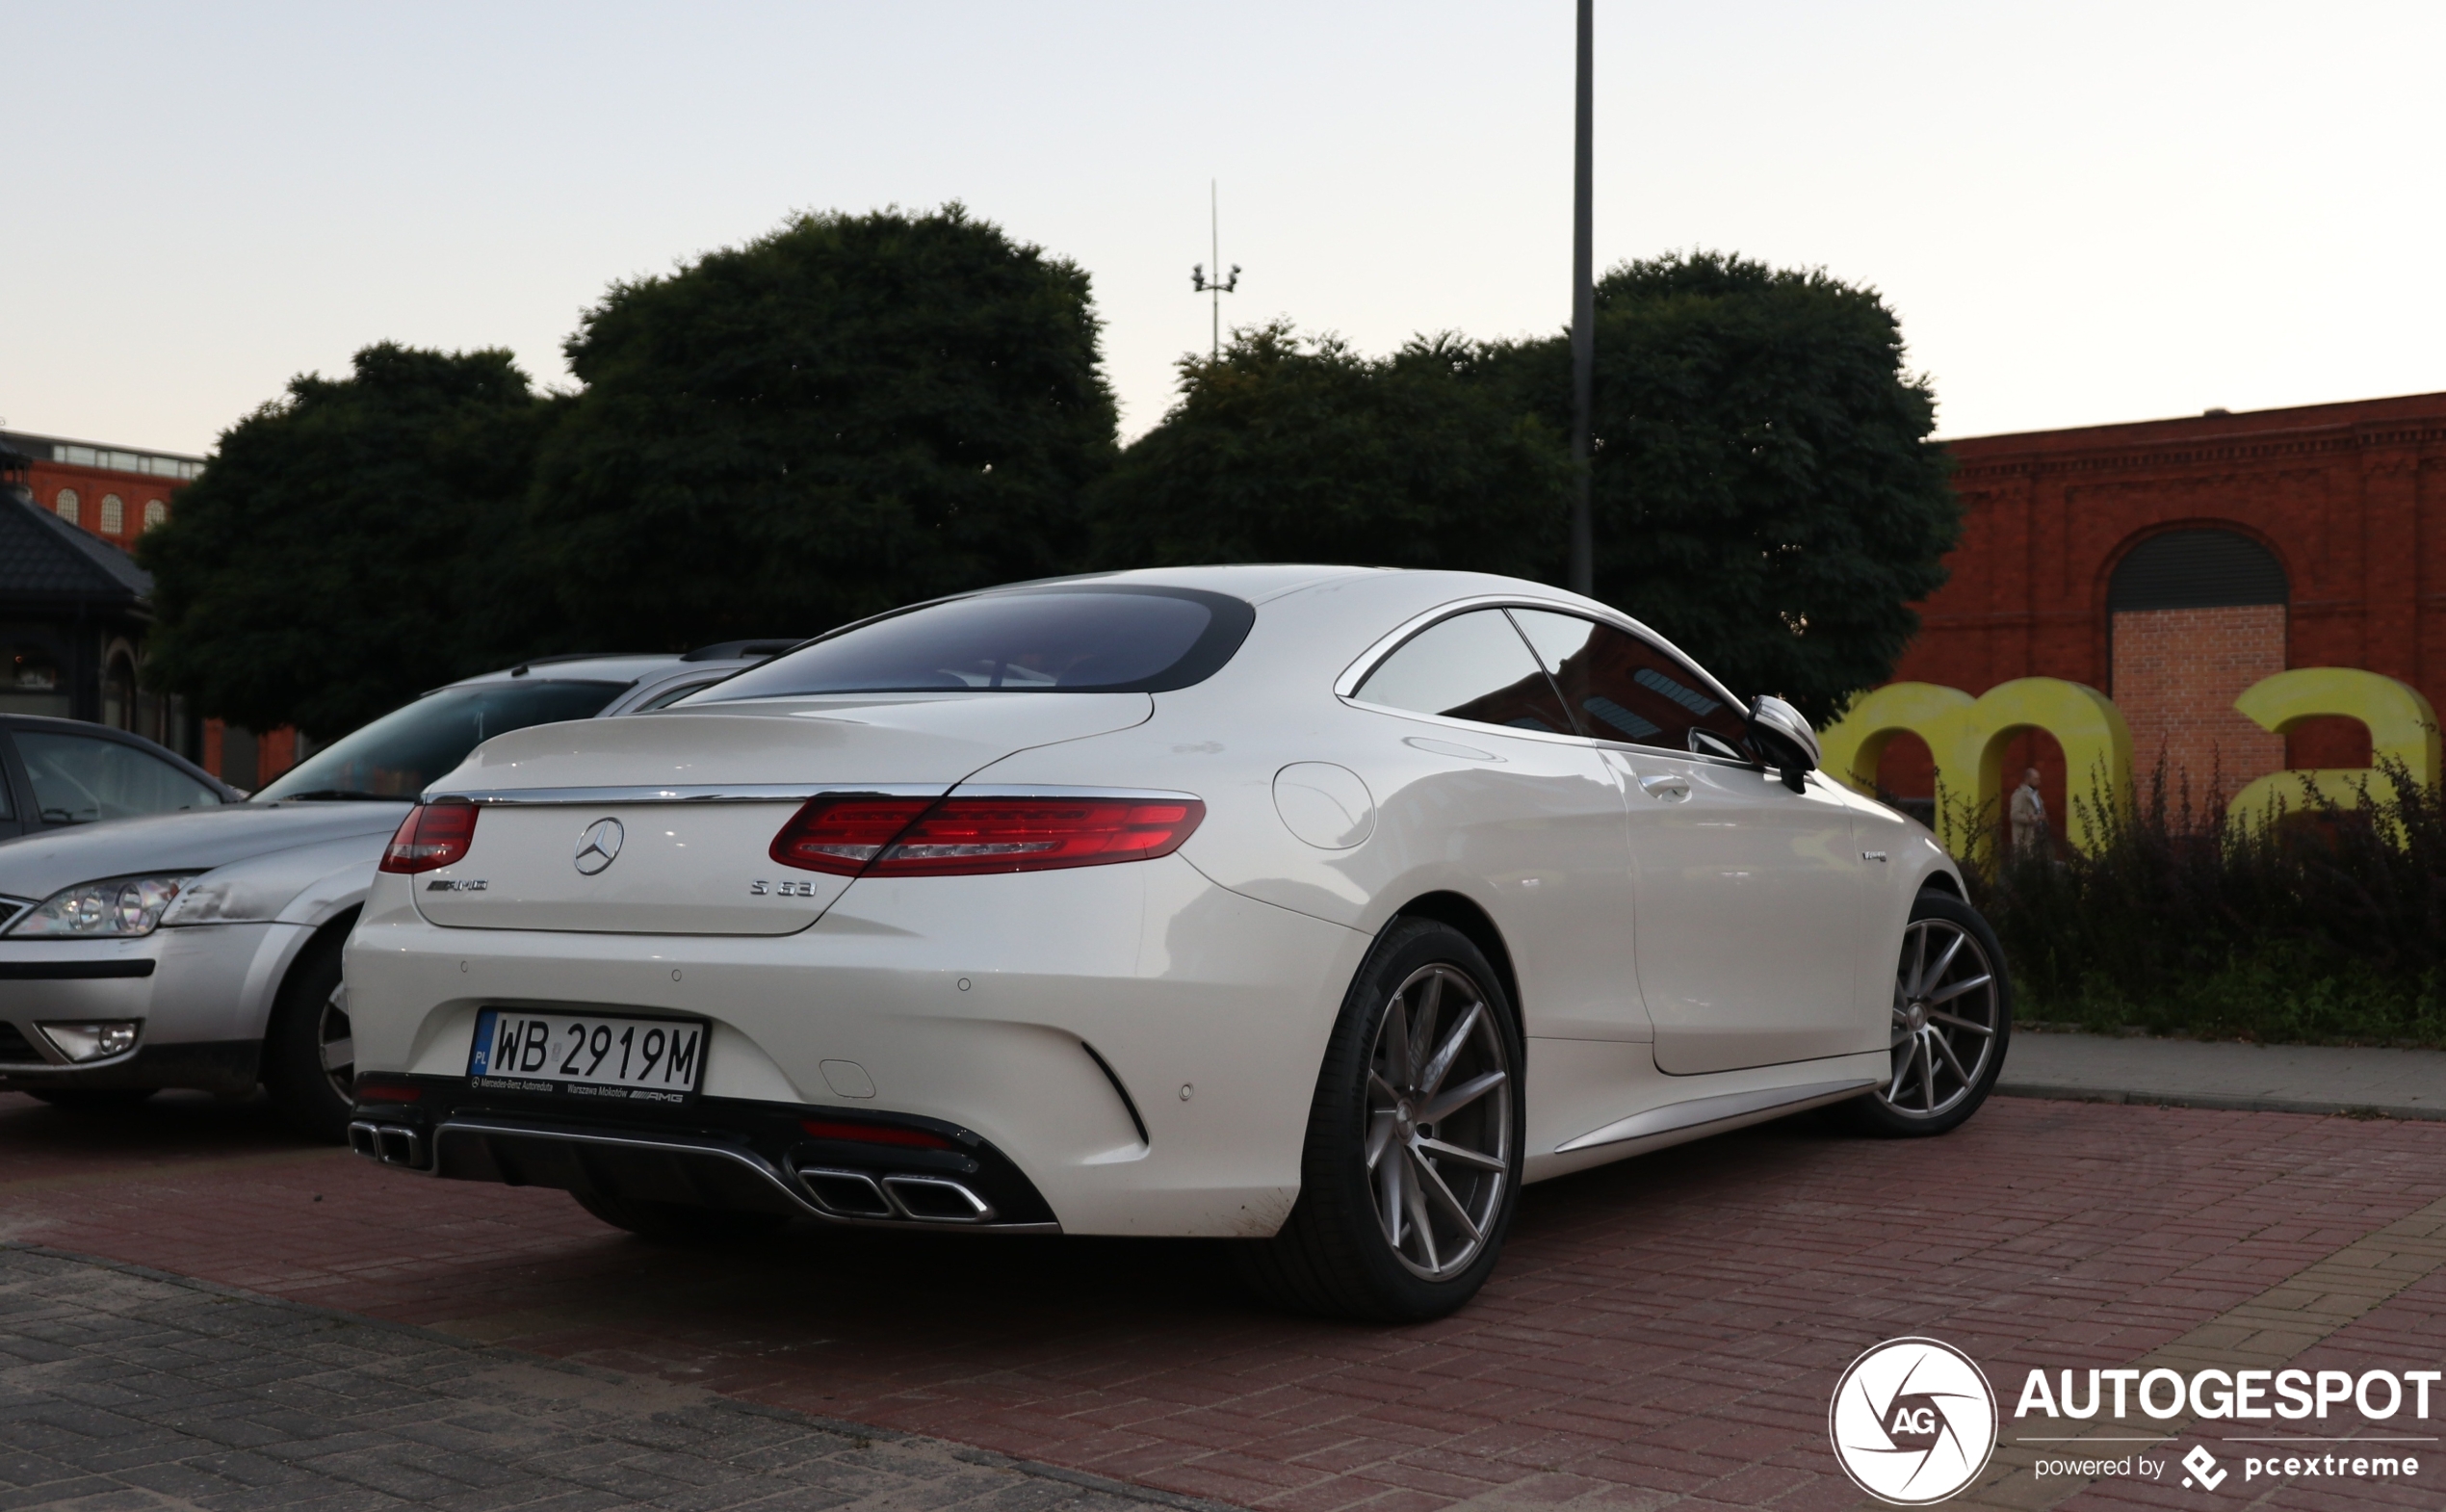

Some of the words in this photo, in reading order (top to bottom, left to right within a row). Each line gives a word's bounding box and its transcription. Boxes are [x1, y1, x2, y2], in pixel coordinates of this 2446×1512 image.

[446, 879, 488, 891] AMG
[750, 878, 769, 895] S
[777, 879, 817, 897] 63
[474, 1051, 486, 1065] PL
[495, 1019, 550, 1073] WB
[559, 1023, 698, 1085] 2919M
[481, 1078, 521, 1090] Mercedes-Benz
[522, 1080, 554, 1092] Autoreduta
[567, 1083, 597, 1096] Warszawa
[599, 1085, 628, 1098] Mokotów
[648, 1090, 684, 1103] AMG
